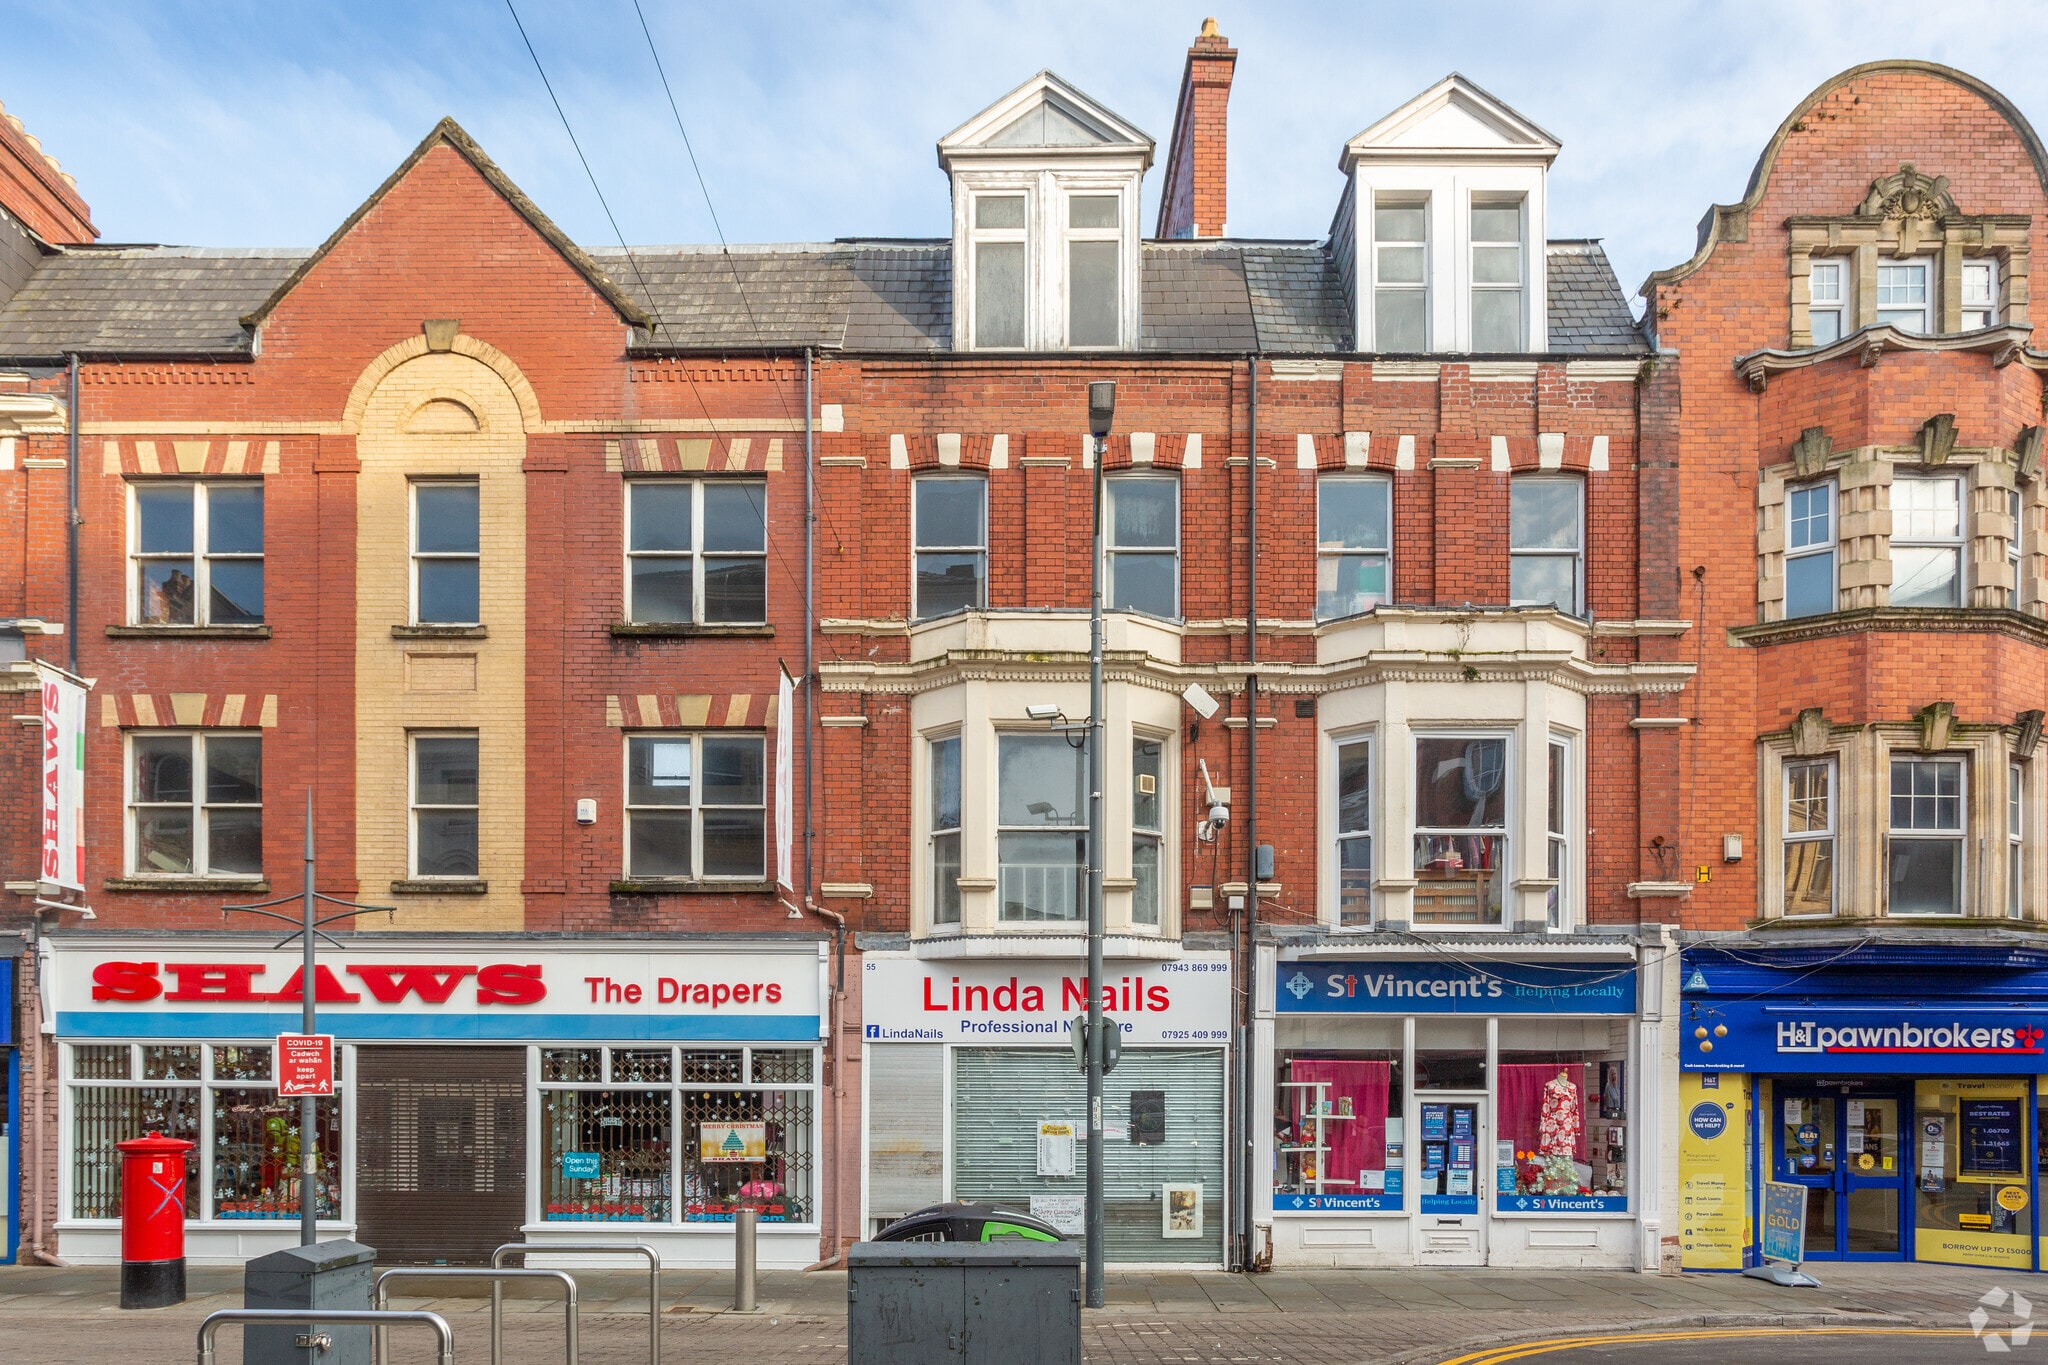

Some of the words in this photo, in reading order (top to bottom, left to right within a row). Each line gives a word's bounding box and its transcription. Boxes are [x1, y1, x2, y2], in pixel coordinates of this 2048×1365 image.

[42, 682, 59, 879] SHAWS
[866, 963, 876, 971] 55
[1161, 964, 1189, 972] 07943
[1191, 964, 1208, 972] 869
[1210, 964, 1228, 972] 999
[92, 961, 547, 1005] SHAWS
[1327, 974, 1358, 998] St
[1364, 974, 1503, 998] Vincent's
[584, 977, 642, 1004] The
[658, 977, 782, 1008] Drapers
[923, 976, 1044, 1012] Linda
[1062, 976, 1170, 1012] Nails
[1515, 986, 1570, 998] Helping
[1574, 986, 1625, 998] Locally
[961, 1020, 1058, 1033] Professional
[882, 1029, 944, 1038] LindaNails
[1161, 1031, 1189, 1039] 07925
[1191, 1031, 1208, 1039] 409
[1210, 1031, 1228, 1039] 999
[286, 1039, 323, 1047] COVID-19
[295, 1073, 316, 1081] apart
[564, 1156, 585, 1166] Open
[569, 1165, 594, 1174] Sunday
[1308, 1197, 1322, 1208] St
[1324, 1196, 1380, 1208] Vincent's
[1451, 1198, 1476, 1206] Locally
[1532, 1198, 1546, 1209] St
[1548, 1198, 1605, 1209] Vincent's
[547, 1204, 643, 1213] SHAWS
[547, 1213, 645, 1222] DIRECT.com
[1768, 1213, 1800, 1230] GOLD
[1942, 1243, 1979, 1251] BORROW
[2006, 1247, 2032, 1255] £5000
